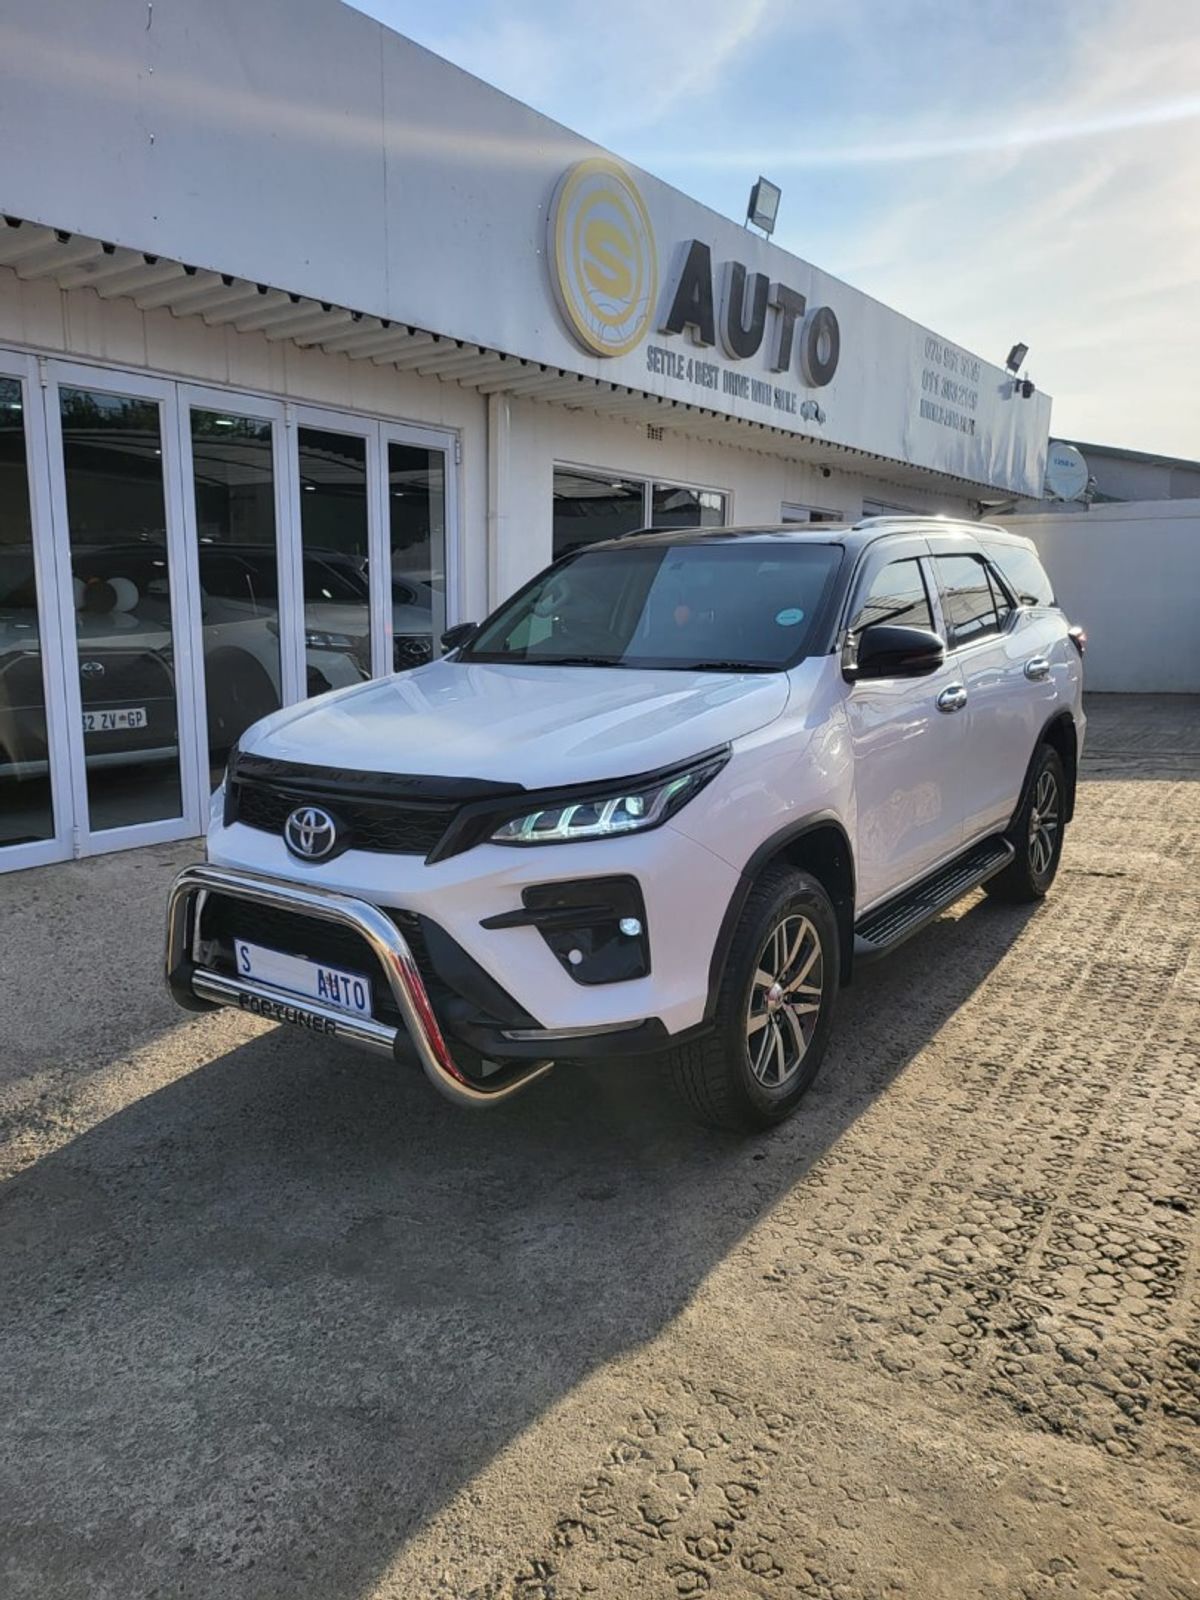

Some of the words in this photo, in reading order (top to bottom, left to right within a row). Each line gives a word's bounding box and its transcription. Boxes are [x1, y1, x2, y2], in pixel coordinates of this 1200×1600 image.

[583, 218, 633, 300] S
[658, 238, 840, 388] AUTO
[646, 344, 685, 380] SETTLE
[686, 358, 693, 383] 4
[694, 360, 719, 391] BEST
[723, 369, 749, 400] DRIVE
[100, 713, 116, 729] ZV
[127, 711, 142, 727] GP
[240, 945, 251, 973] S
[317, 968, 365, 1011] AUTO
[239, 992, 338, 1038] FORTUNER
